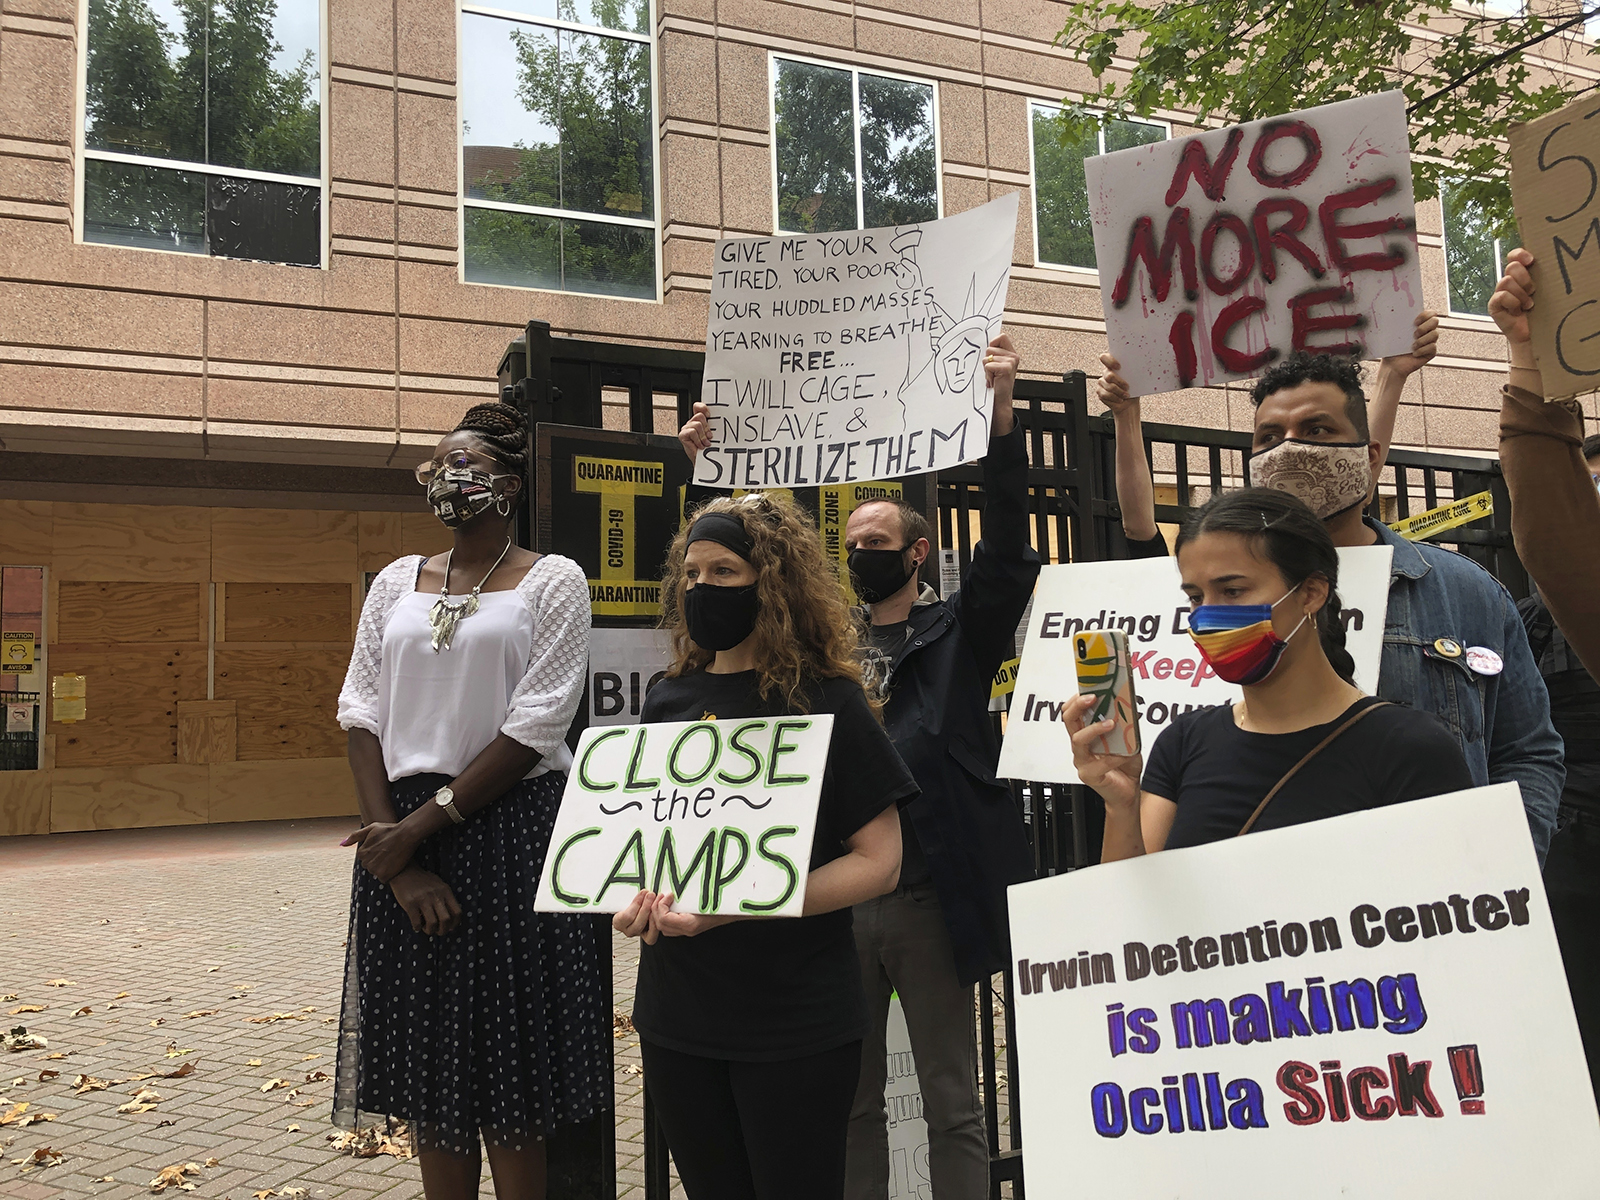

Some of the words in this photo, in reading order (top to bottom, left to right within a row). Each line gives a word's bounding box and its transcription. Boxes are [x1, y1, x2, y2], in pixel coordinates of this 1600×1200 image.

[1165, 120, 1323, 207] NO
[721, 240, 771, 263] GIVE
[780, 238, 806, 262] ME
[817, 235, 878, 257] YOUR
[1111, 177, 1412, 309] MORE
[793, 267, 840, 284] YOUR
[715, 300, 762, 321] YOUR
[772, 296, 855, 317] HUDDLED
[860, 286, 935, 311] MASSES
[711, 329, 804, 352] YEARNING
[814, 330, 832, 345] TO
[840, 314, 943, 345] BREATHE
[1169, 282, 1367, 387] ICE
[780, 350, 855, 373] FREE...
[706, 379, 732, 407] I
[734, 378, 794, 409] WILL
[845, 407, 868, 433] &
[698, 440, 861, 485] STERILIZE
[865, 418, 969, 477] THEM
[577, 461, 663, 485] QUARANTINE
[825, 490, 840, 524] ZONE
[1409, 508, 1453, 534] QUARANTINE
[1452, 502, 1472, 518] ZONE
[607, 509, 625, 568] COVID-19
[588, 585, 661, 603] UARANTINE
[1040, 609, 1161, 642] Ending
[593, 671, 667, 717] BI
[994, 669, 1009, 686] DO
[578, 720, 812, 793] CLOSE
[652, 786, 716, 822] the
[551, 826, 798, 915] CAMPS
[1018, 949, 1116, 996] Irwin
[1124, 914, 1343, 982] Detention
[1350, 886, 1531, 949] Center
[1106, 1002, 1161, 1058] is
[1170, 971, 1427, 1050] making
[1091, 1071, 1269, 1139] Ocilla
